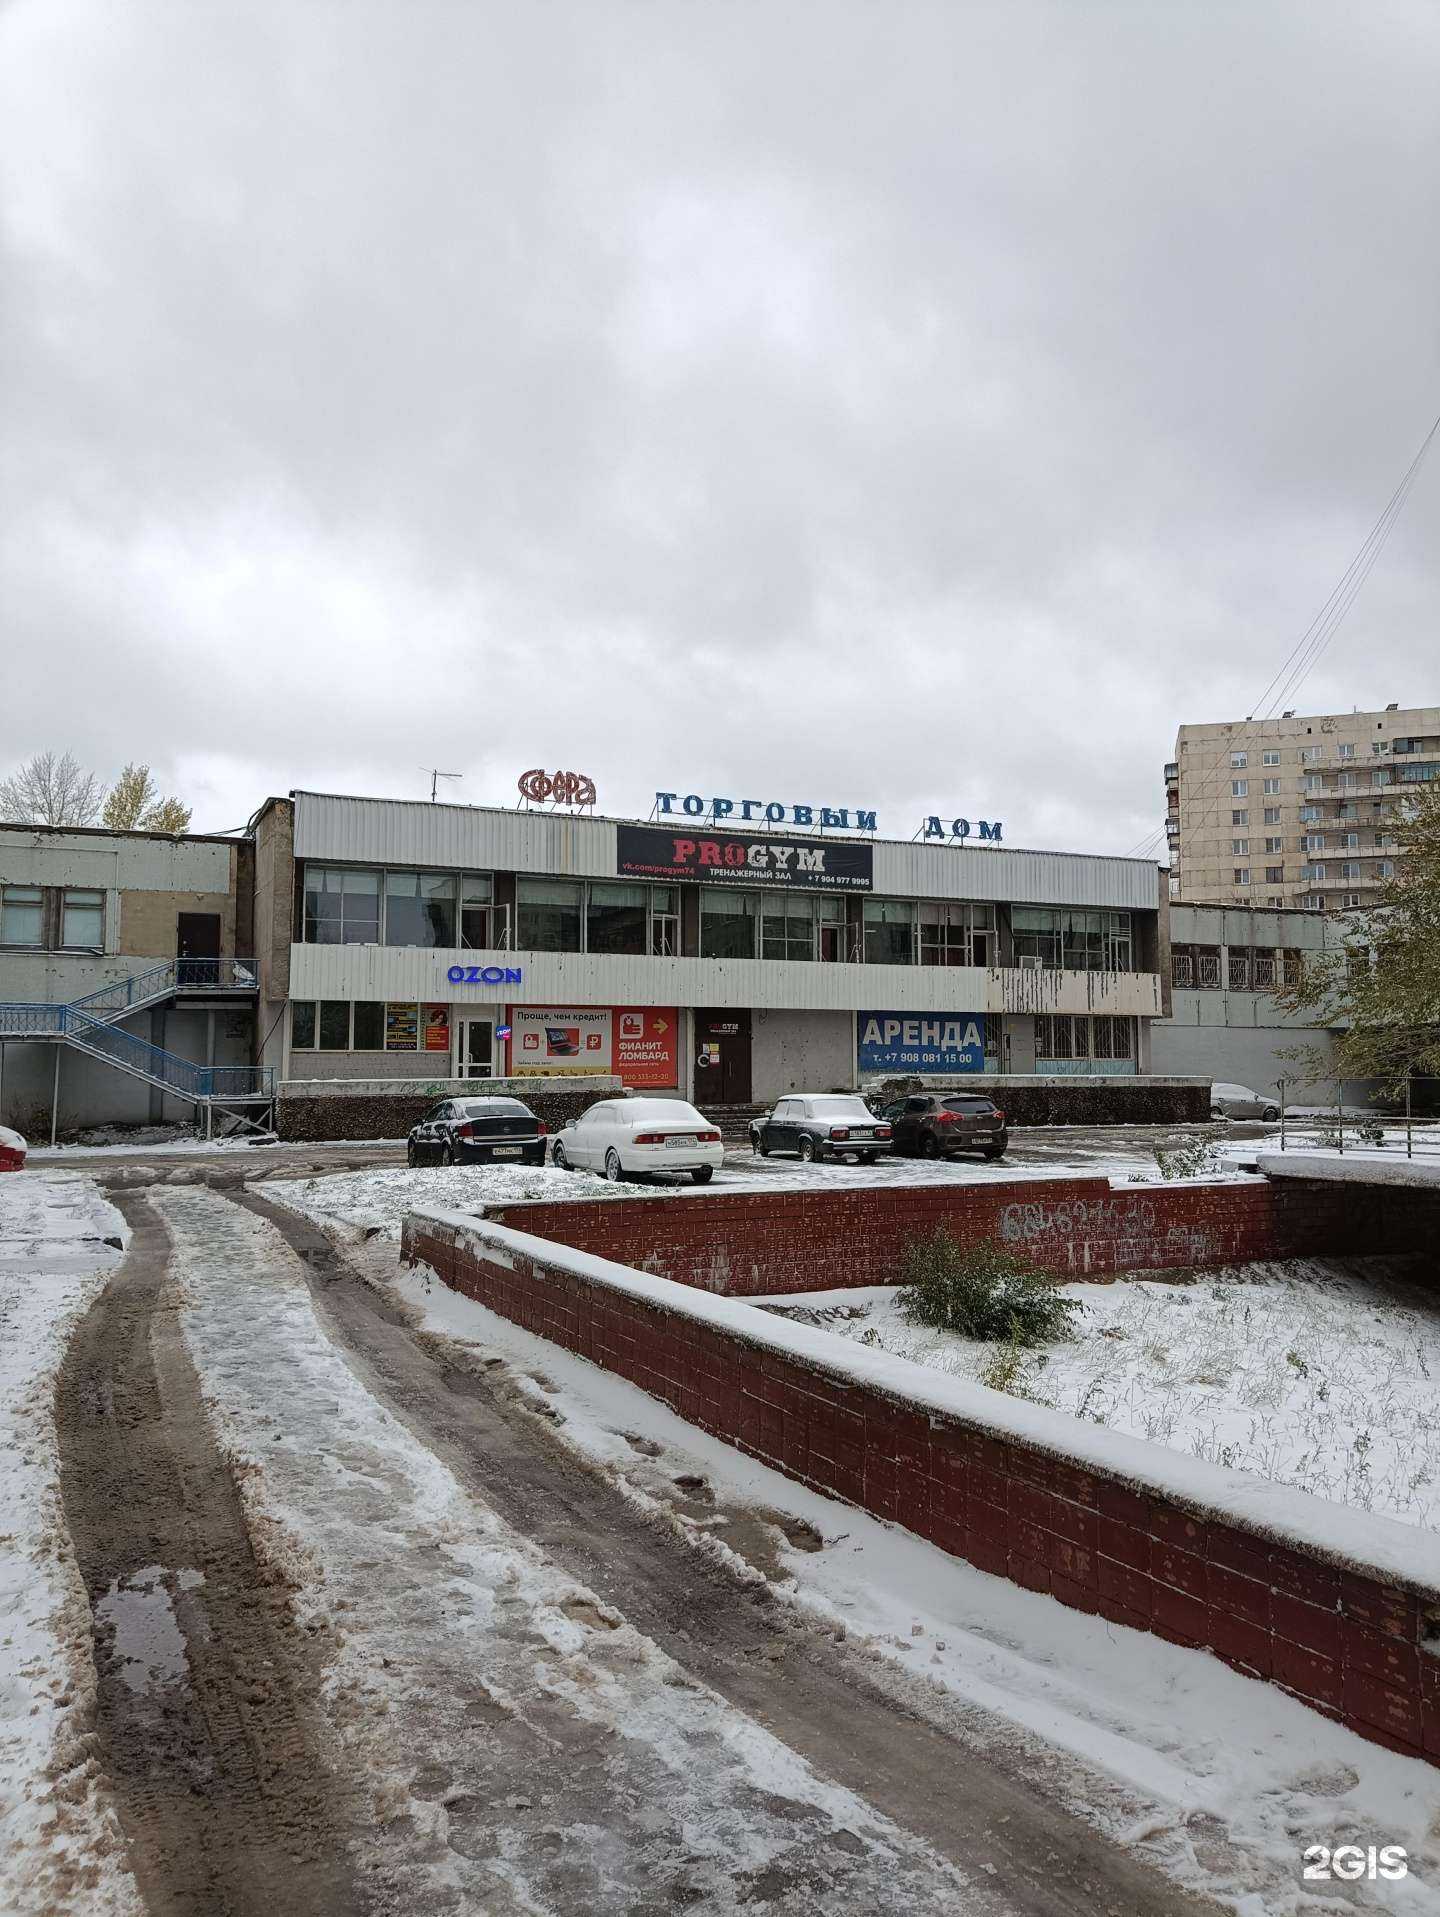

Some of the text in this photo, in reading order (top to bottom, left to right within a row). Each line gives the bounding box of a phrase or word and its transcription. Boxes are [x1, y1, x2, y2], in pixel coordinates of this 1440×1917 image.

[924, 816, 1003, 841] ДОМ
[672, 839, 826, 872] PROGYM
[622, 862, 695, 875] vk.com/progym74
[710, 868, 792, 880] ТРЕНАЖЕРНЫЙ ЗАЛ
[821, 875, 835, 883] 904
[447, 966, 522, 984] OZON
[517, 1012, 551, 1022] Проще,
[573, 1013, 607, 1021] кредит!
[862, 1018, 982, 1052] АРЕНДА
[618, 1042, 662, 1050] ФИАНИТ
[618, 1051, 669, 1061] ЛОМБАРД
[873, 1053, 972, 1063] т. +7 908 081 15 00
